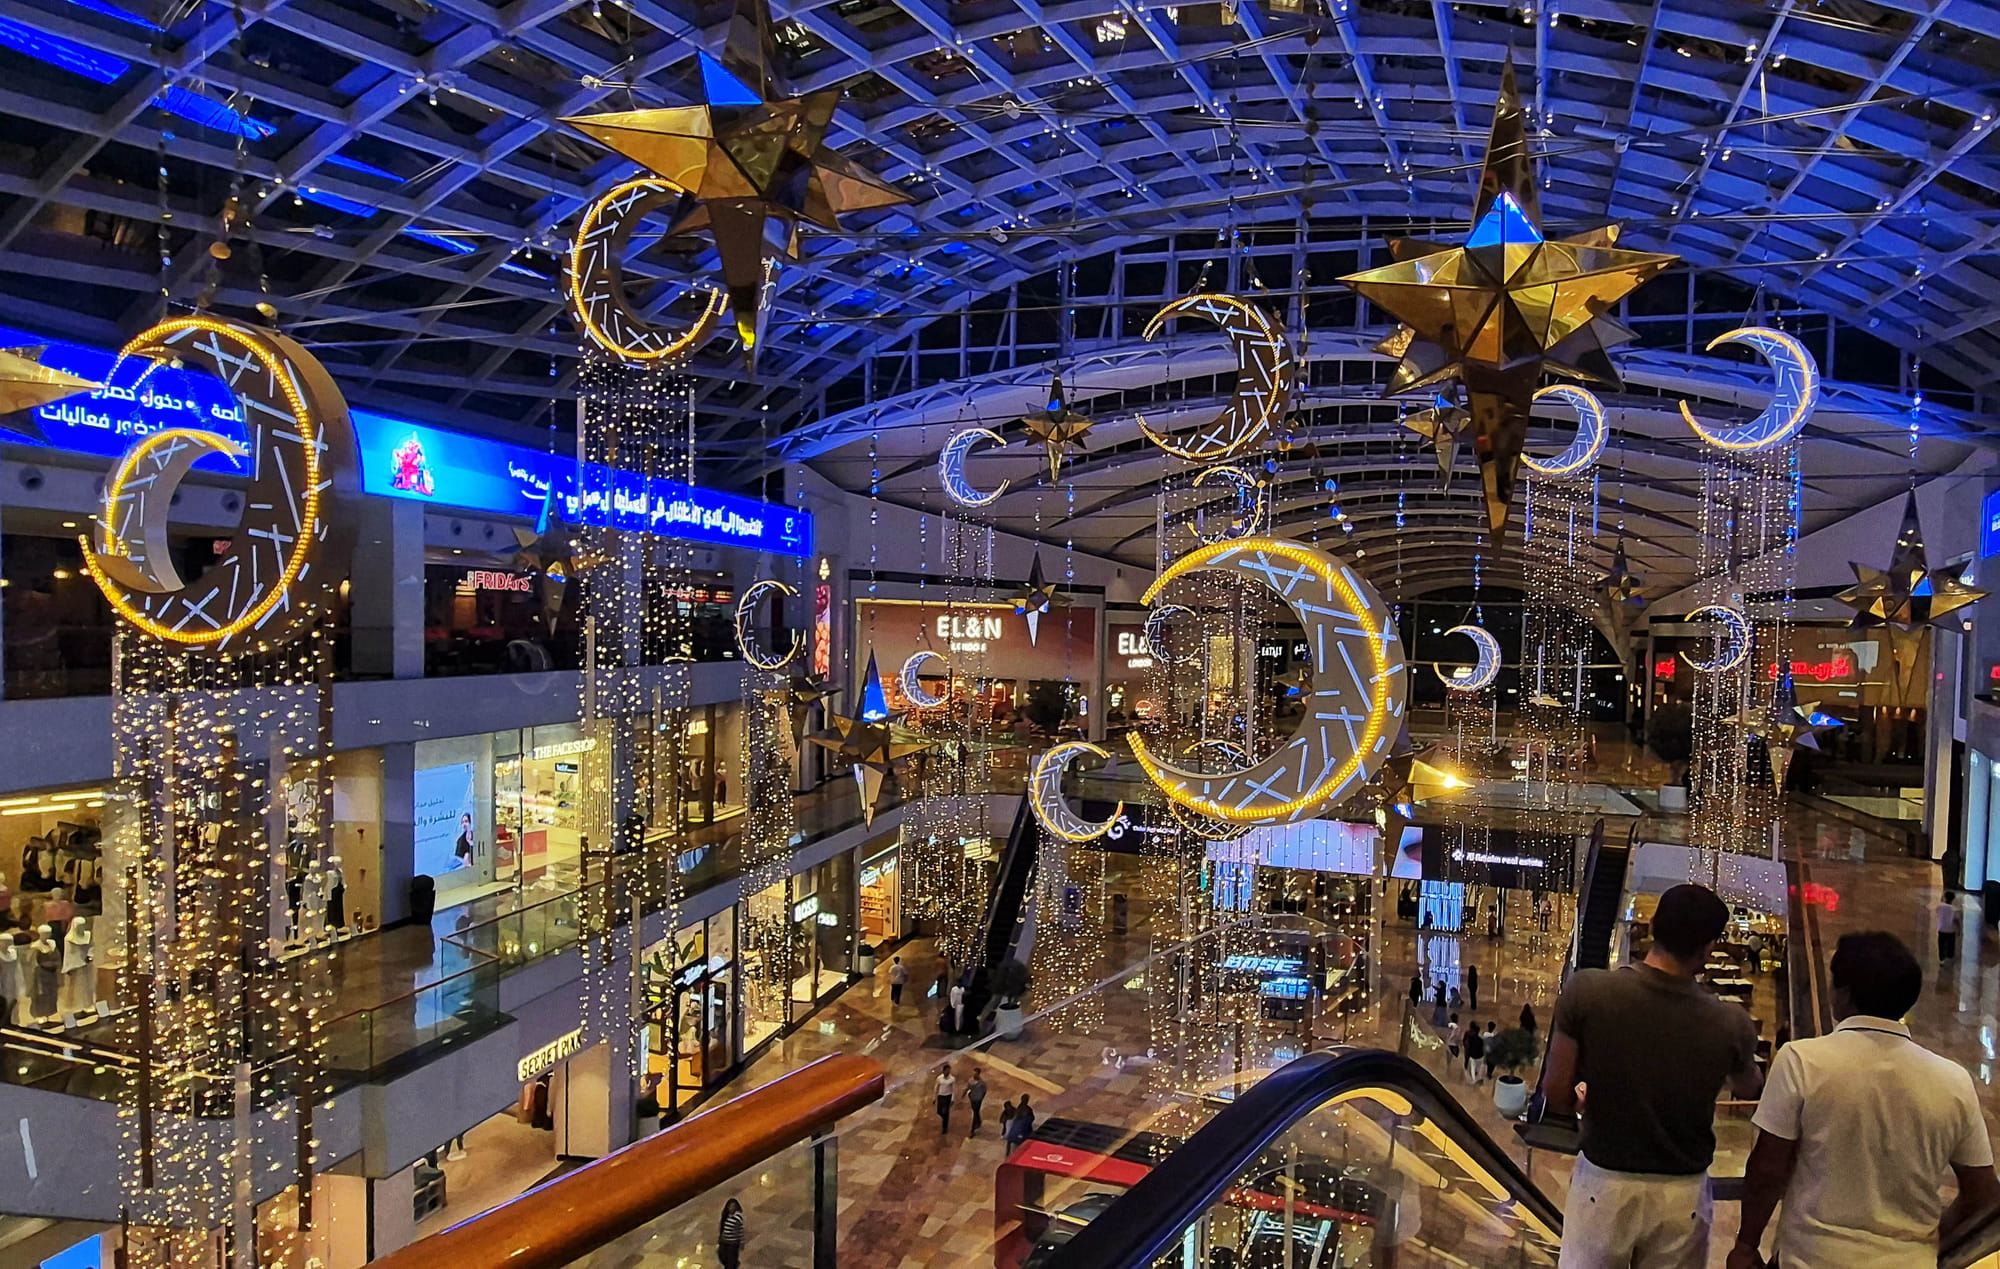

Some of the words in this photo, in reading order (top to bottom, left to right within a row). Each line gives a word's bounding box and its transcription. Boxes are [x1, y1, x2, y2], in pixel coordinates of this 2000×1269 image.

[40, 404, 110, 430] فعاليات
[936, 615, 1002, 639] EL&N
[1223, 955, 1303, 973] BOSE
[521, 1044, 557, 1079] SECRET
